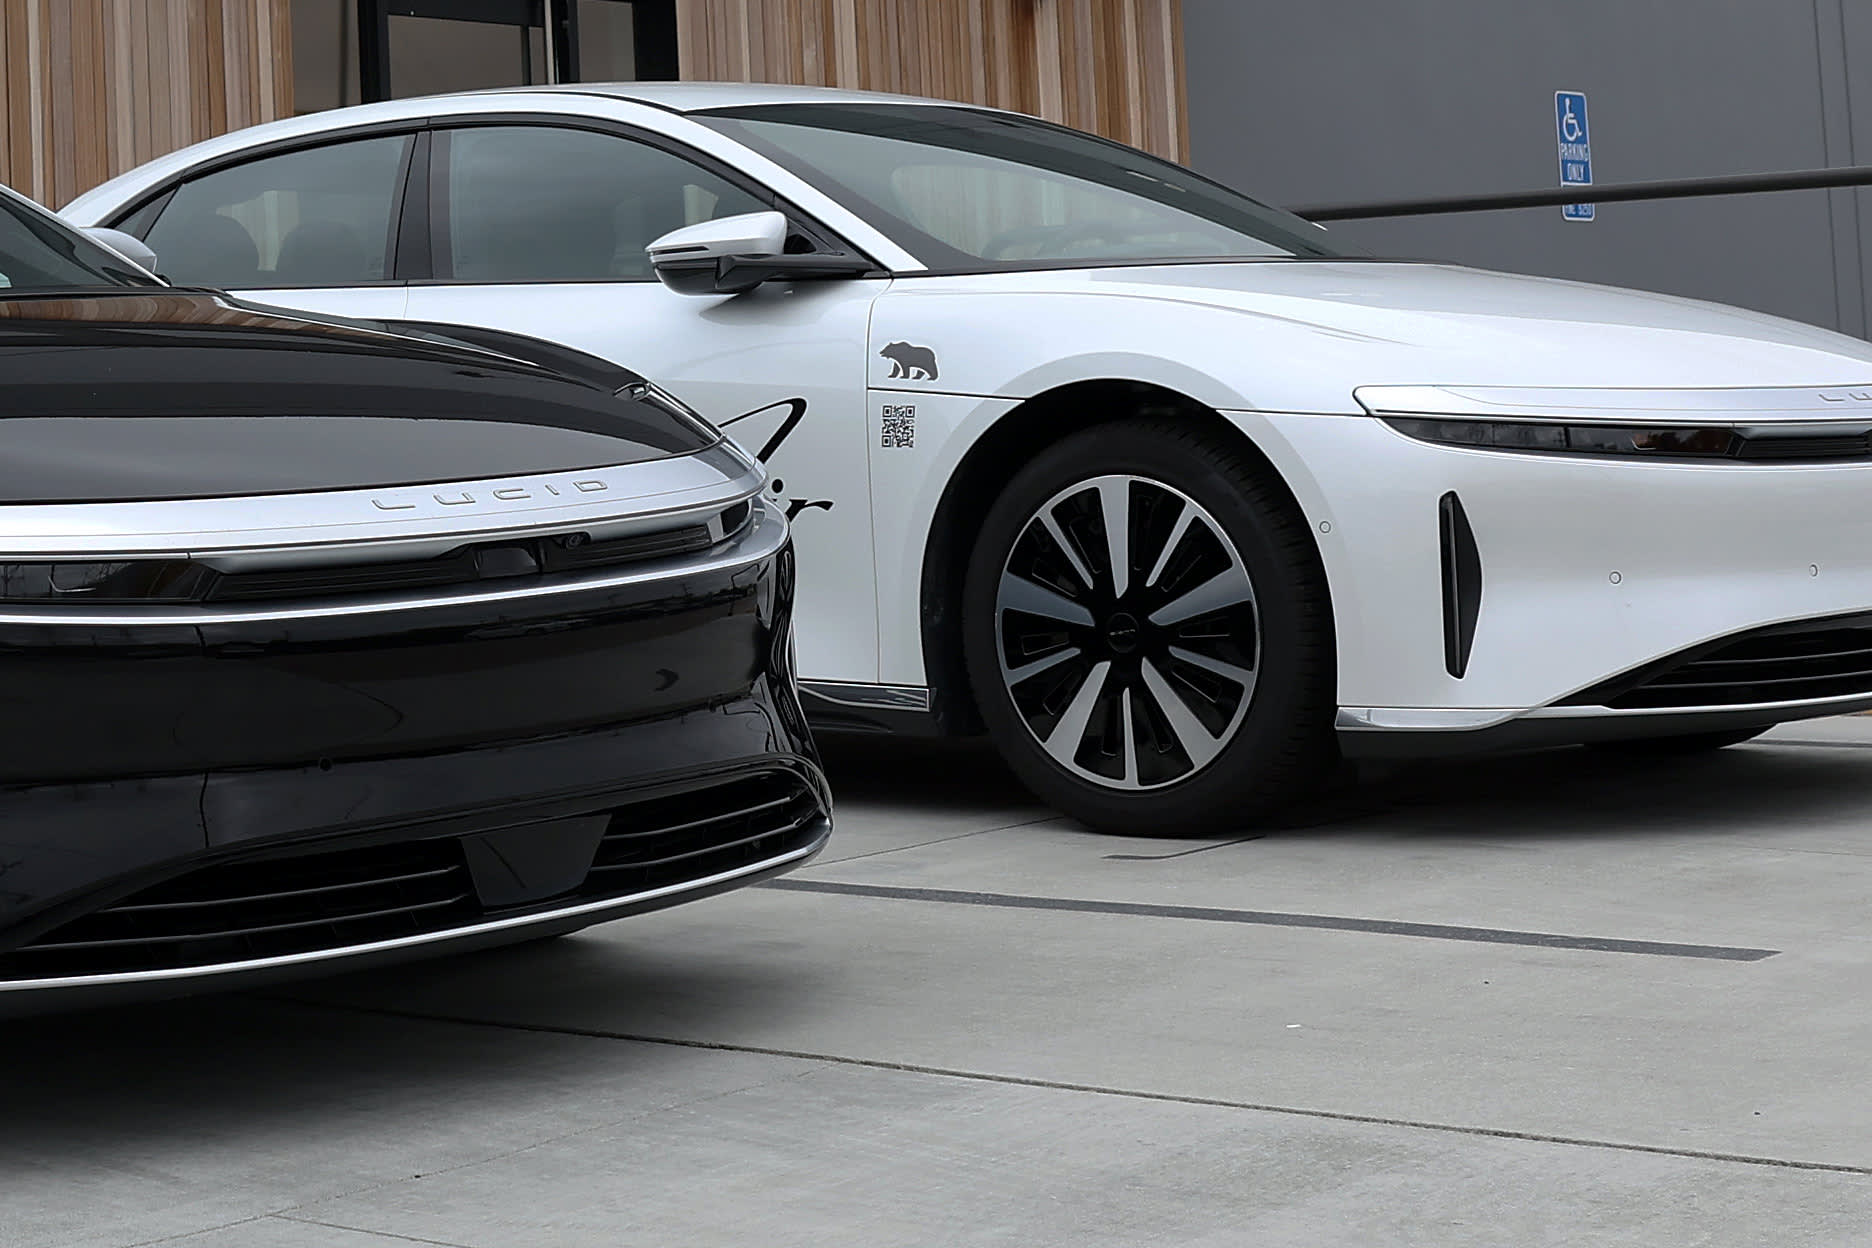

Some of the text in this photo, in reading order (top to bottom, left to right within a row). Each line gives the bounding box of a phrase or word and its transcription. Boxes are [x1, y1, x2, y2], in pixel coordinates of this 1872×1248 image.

[1560, 143, 1589, 162] PARKING
[1567, 163, 1585, 181] ONLY
[371, 480, 609, 511] LUCID
